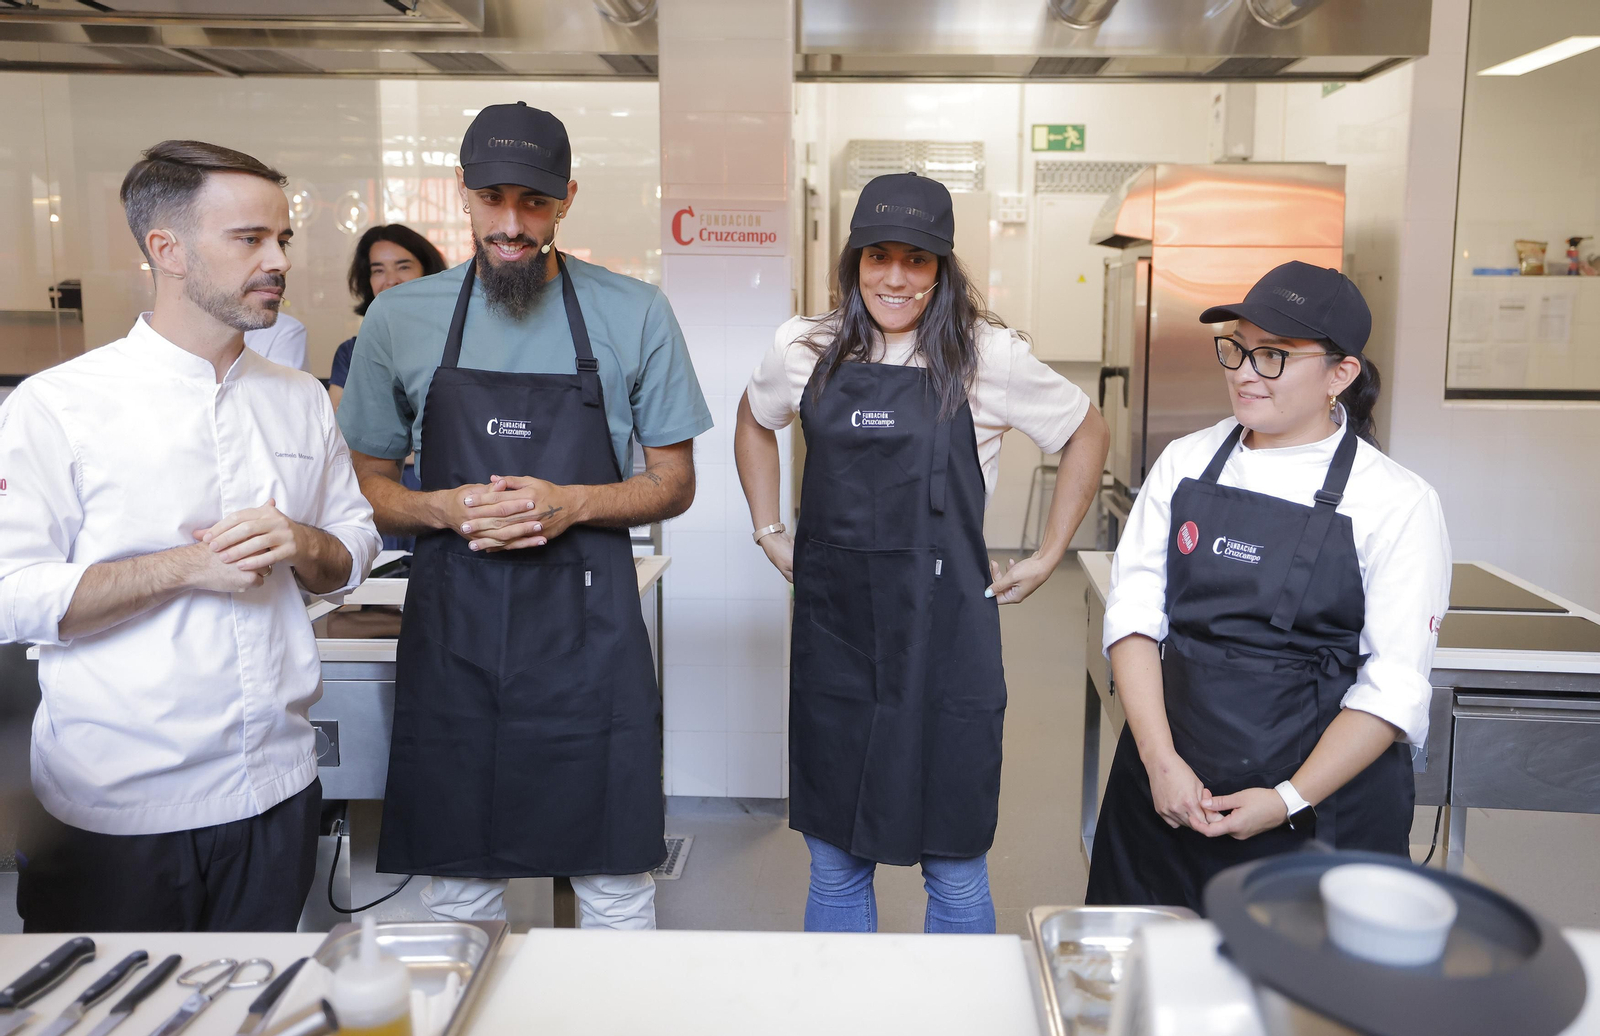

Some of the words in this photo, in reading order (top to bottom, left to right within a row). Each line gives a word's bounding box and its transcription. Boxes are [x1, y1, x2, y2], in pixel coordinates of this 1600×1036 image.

[700, 212, 762, 227] FUNDACIÓN
[699, 227, 777, 245] Cruzcampo
[862, 418, 895, 428] Cruzcampo
[498, 427, 532, 438] Cruzcampo
[1224, 547, 1261, 563] Cruzcampo
